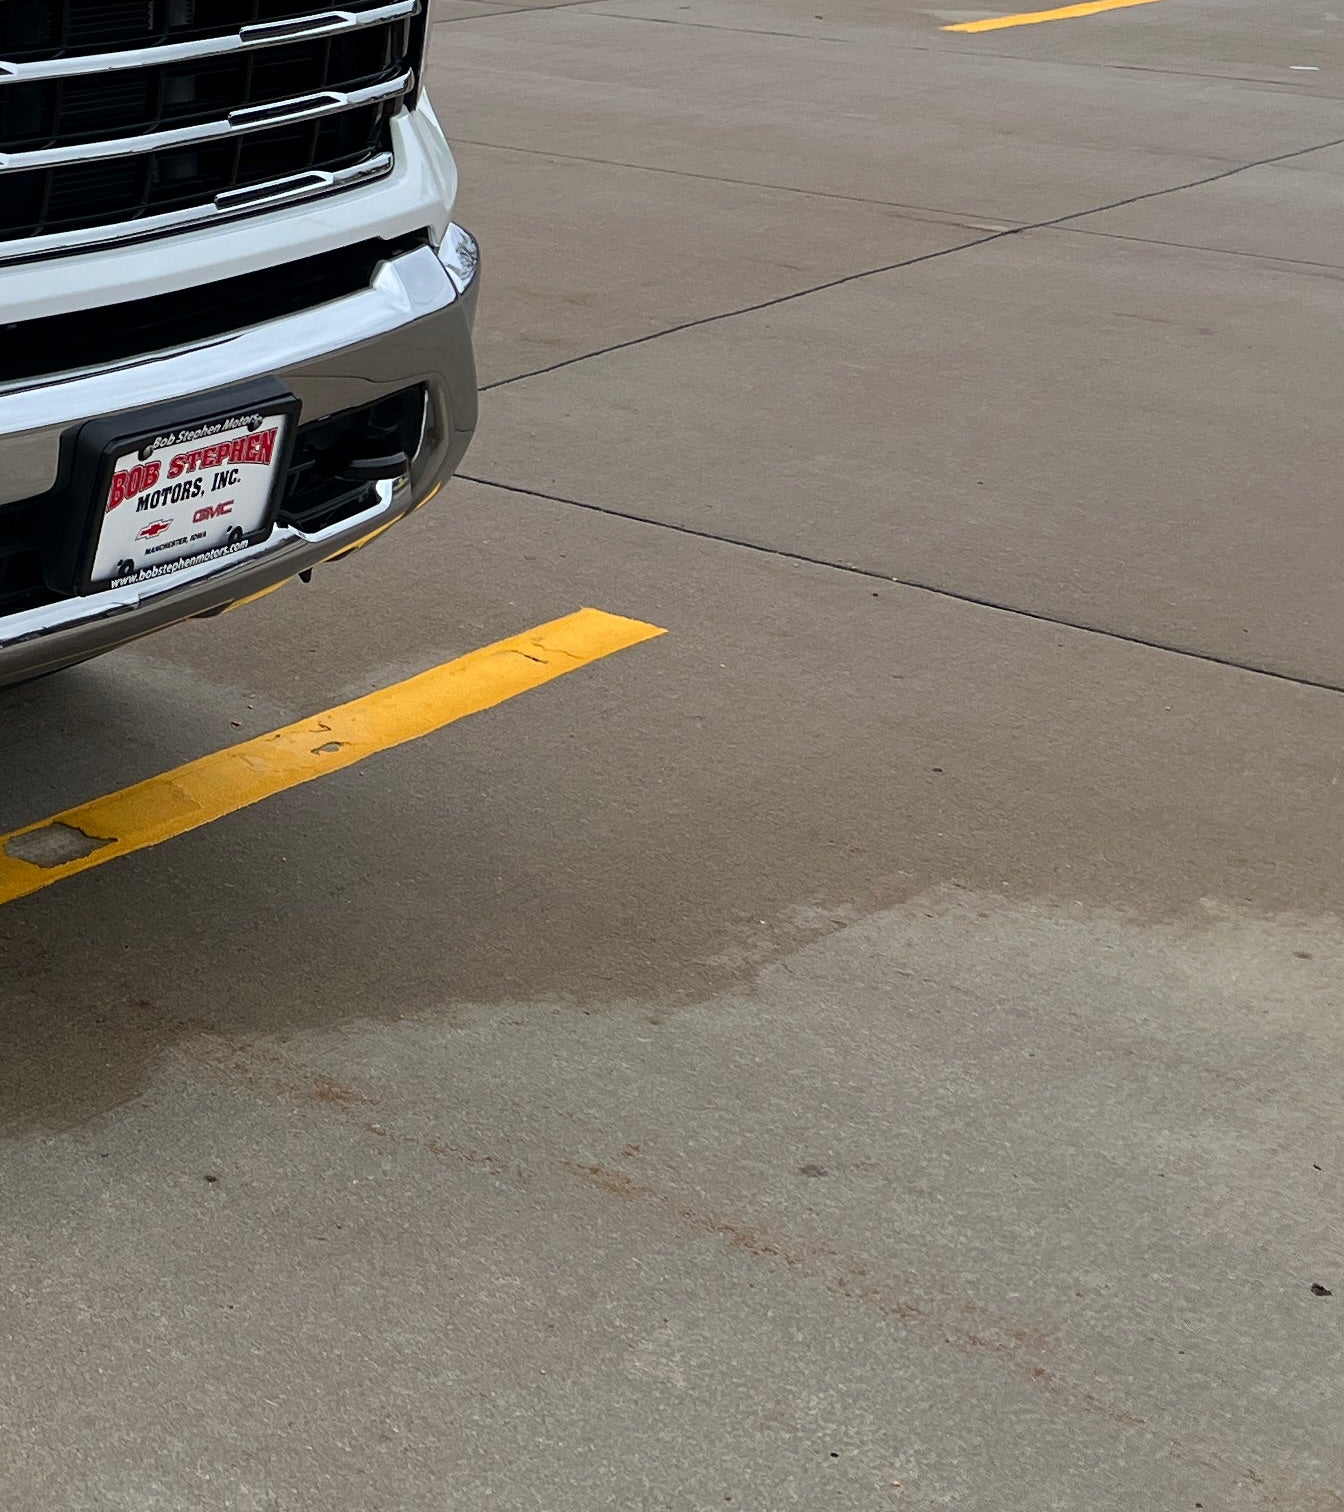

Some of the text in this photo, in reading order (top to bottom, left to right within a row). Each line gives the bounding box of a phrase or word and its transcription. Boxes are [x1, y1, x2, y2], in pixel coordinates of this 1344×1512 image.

[153, 412, 263, 450] Bob Stephen Motors
[105, 426, 279, 514] BOB STEPHEN
[135, 468, 242, 513] MOTORS, INC.
[192, 499, 235, 524] GMC
[111, 539, 250, 589] www.bobstephenmotors.com
